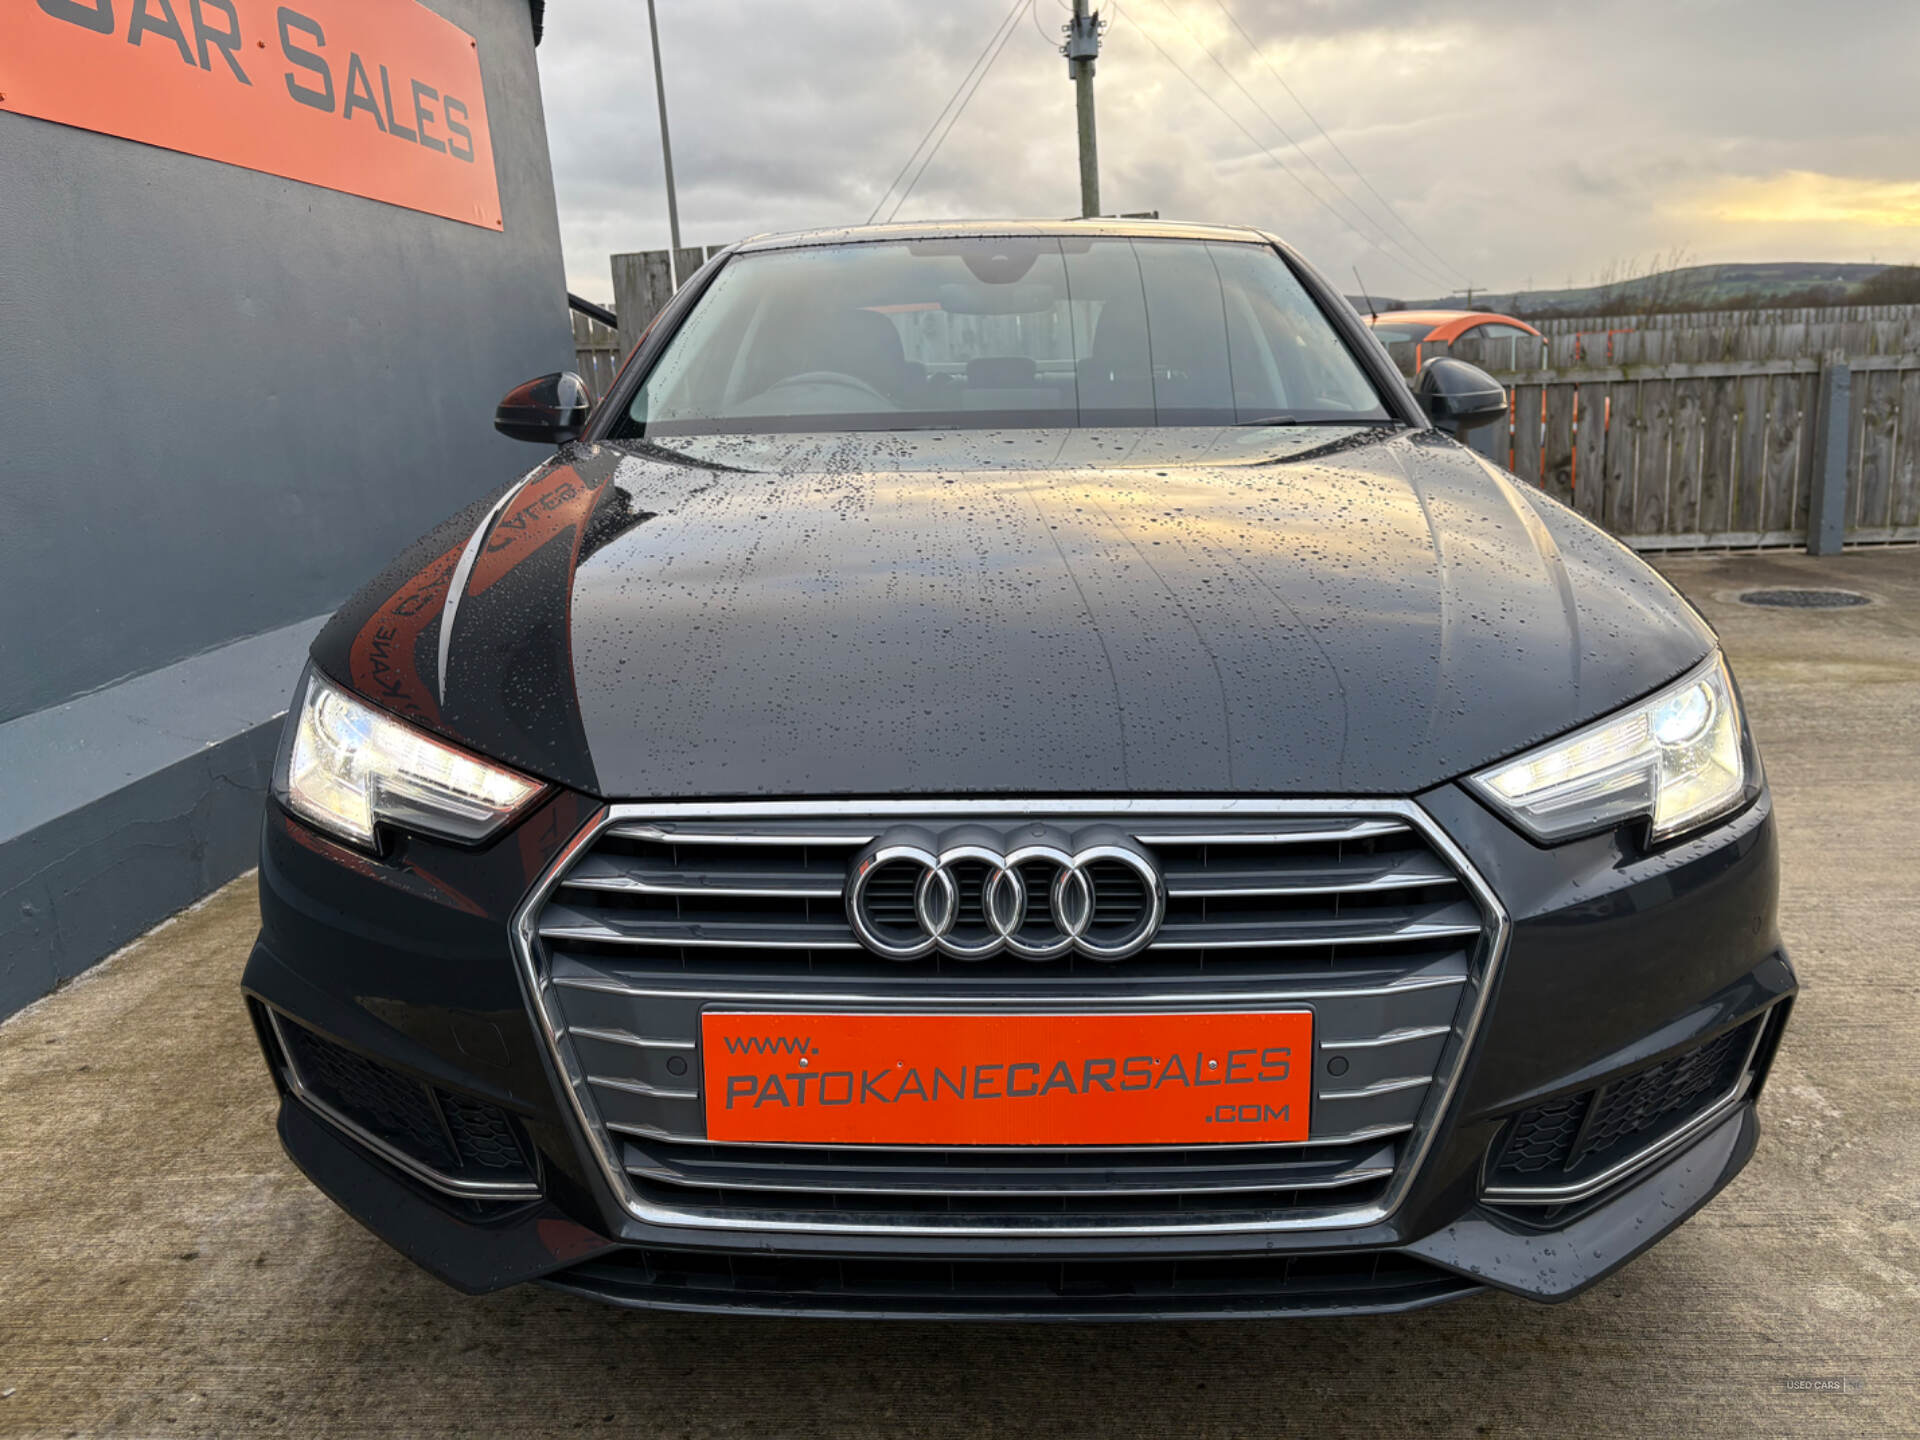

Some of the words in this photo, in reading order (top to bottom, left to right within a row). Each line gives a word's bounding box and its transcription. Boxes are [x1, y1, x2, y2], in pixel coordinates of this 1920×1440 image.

[277, 6, 475, 163] SALES
[725, 1047, 1292, 1110] PATOKANECARSALES
[1205, 1103, 1290, 1124] .COM
